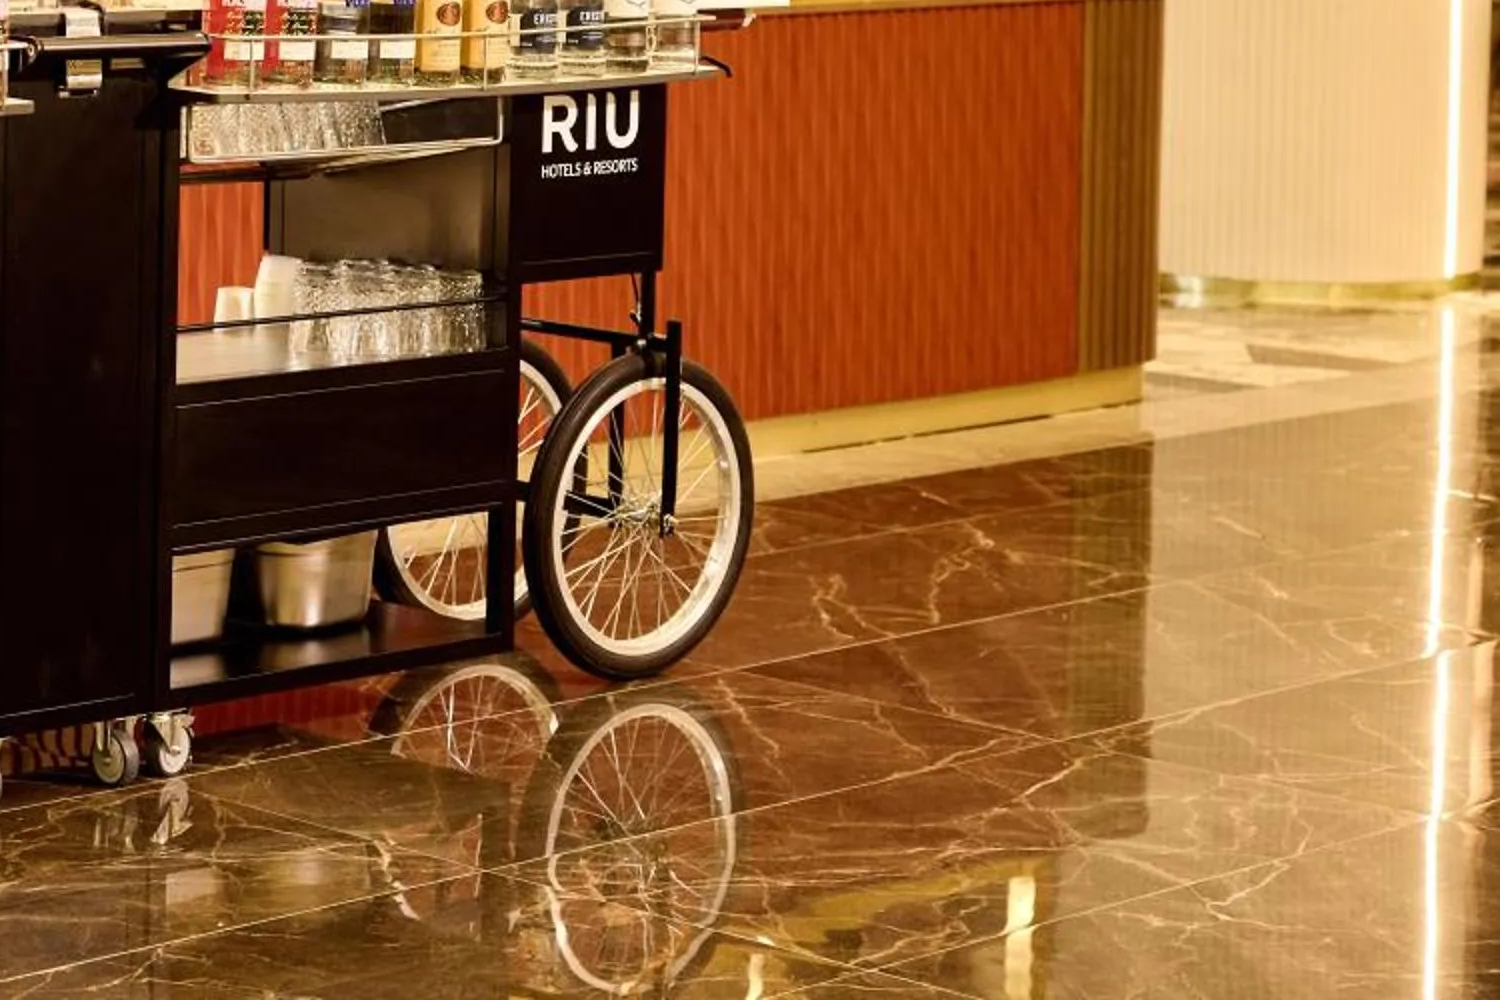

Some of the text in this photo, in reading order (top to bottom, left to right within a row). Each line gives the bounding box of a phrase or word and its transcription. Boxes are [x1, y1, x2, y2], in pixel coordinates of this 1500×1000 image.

[541, 89, 640, 154] RIU
[541, 157, 639, 179] HOTELS & RESORTS
